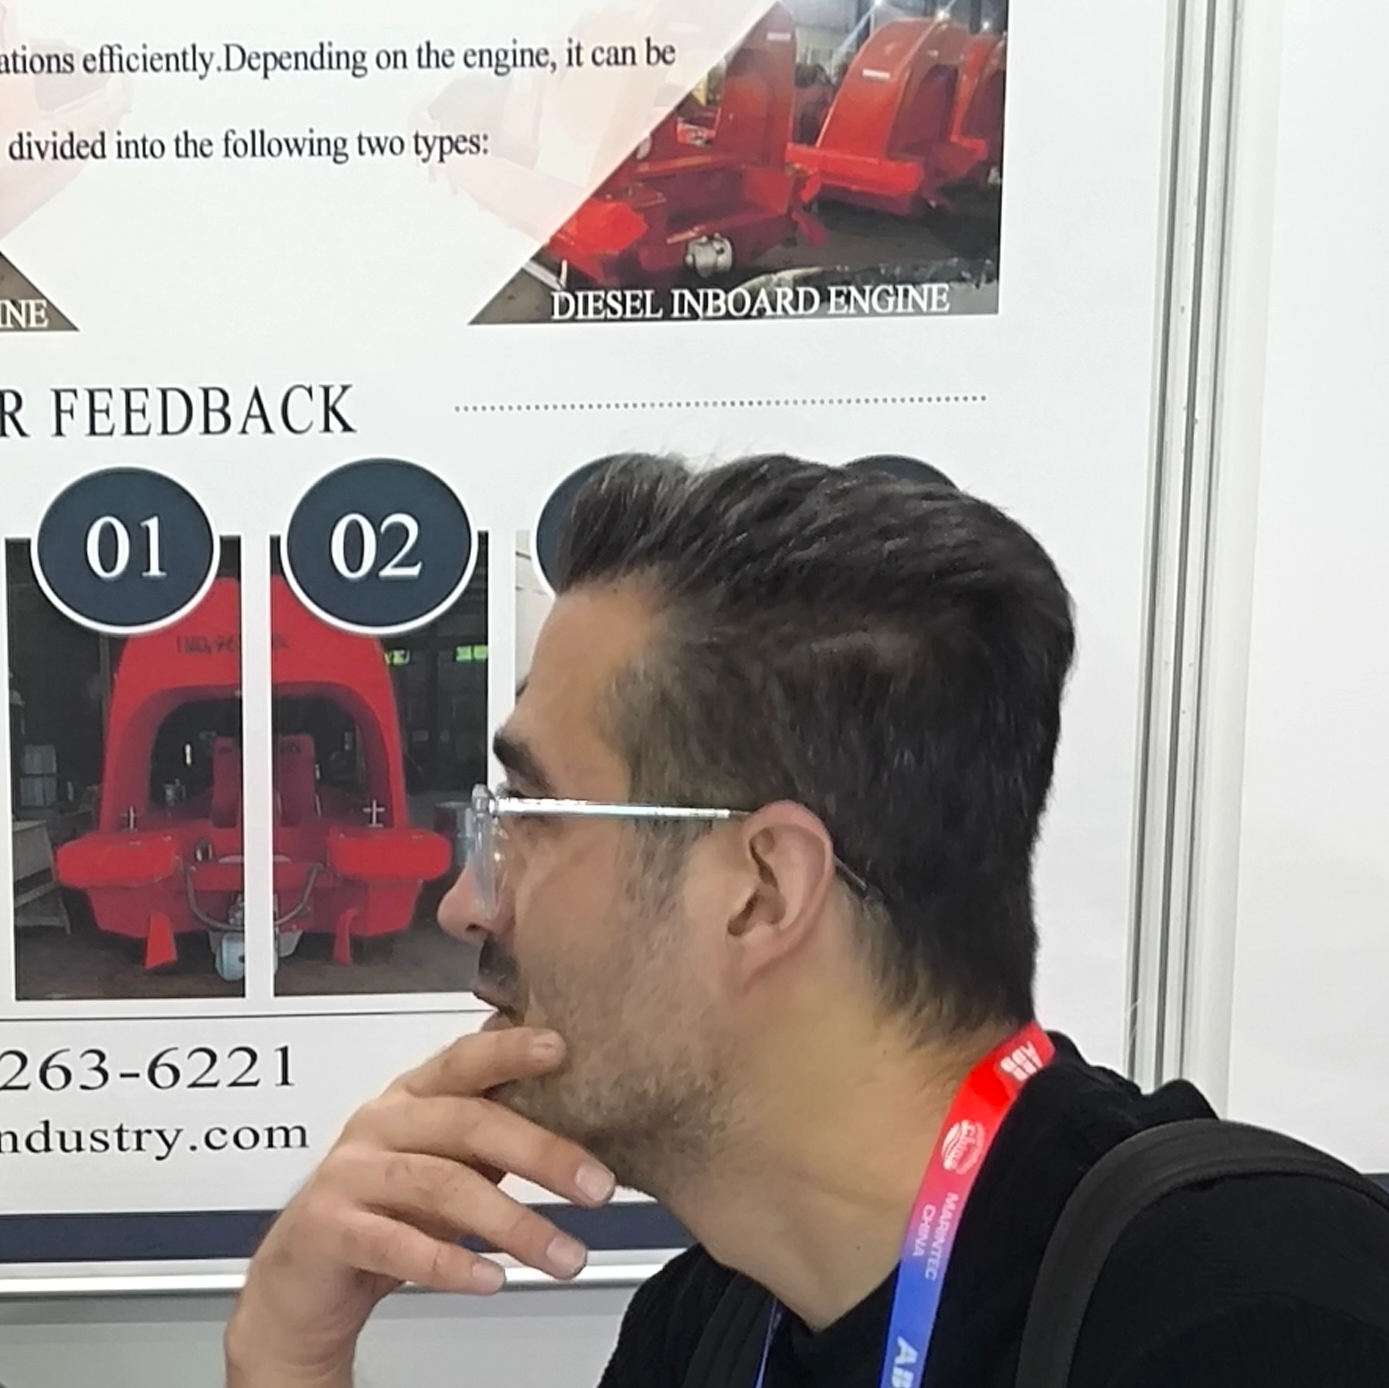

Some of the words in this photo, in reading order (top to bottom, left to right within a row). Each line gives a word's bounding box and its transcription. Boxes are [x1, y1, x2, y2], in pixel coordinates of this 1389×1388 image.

[375, 49, 409, 70] on
[416, 39, 456, 70] the
[462, 38, 557, 77] engine,
[566, 37, 584, 68] it
[590, 45, 638, 68] can
[644, 35, 676, 67] be
[8, 130, 108, 162] divided
[115, 129, 166, 160] into
[173, 129, 214, 159] the
[223, 127, 350, 166] following
[356, 131, 406, 157] two
[412, 130, 489, 164] types:
[551, 291, 663, 320] DIESEL
[670, 287, 820, 319] INBOARD
[827, 282, 951, 315] ENGINE
[49, 383, 358, 438] FEEDBACK
[86, 515, 166, 579] 01
[331, 513, 422, 579] 02
[1000, 1040, 1043, 1081] ABB
[913, 1204, 936, 1257] CHINA
[925, 1191, 960, 1281] MARINTEC
